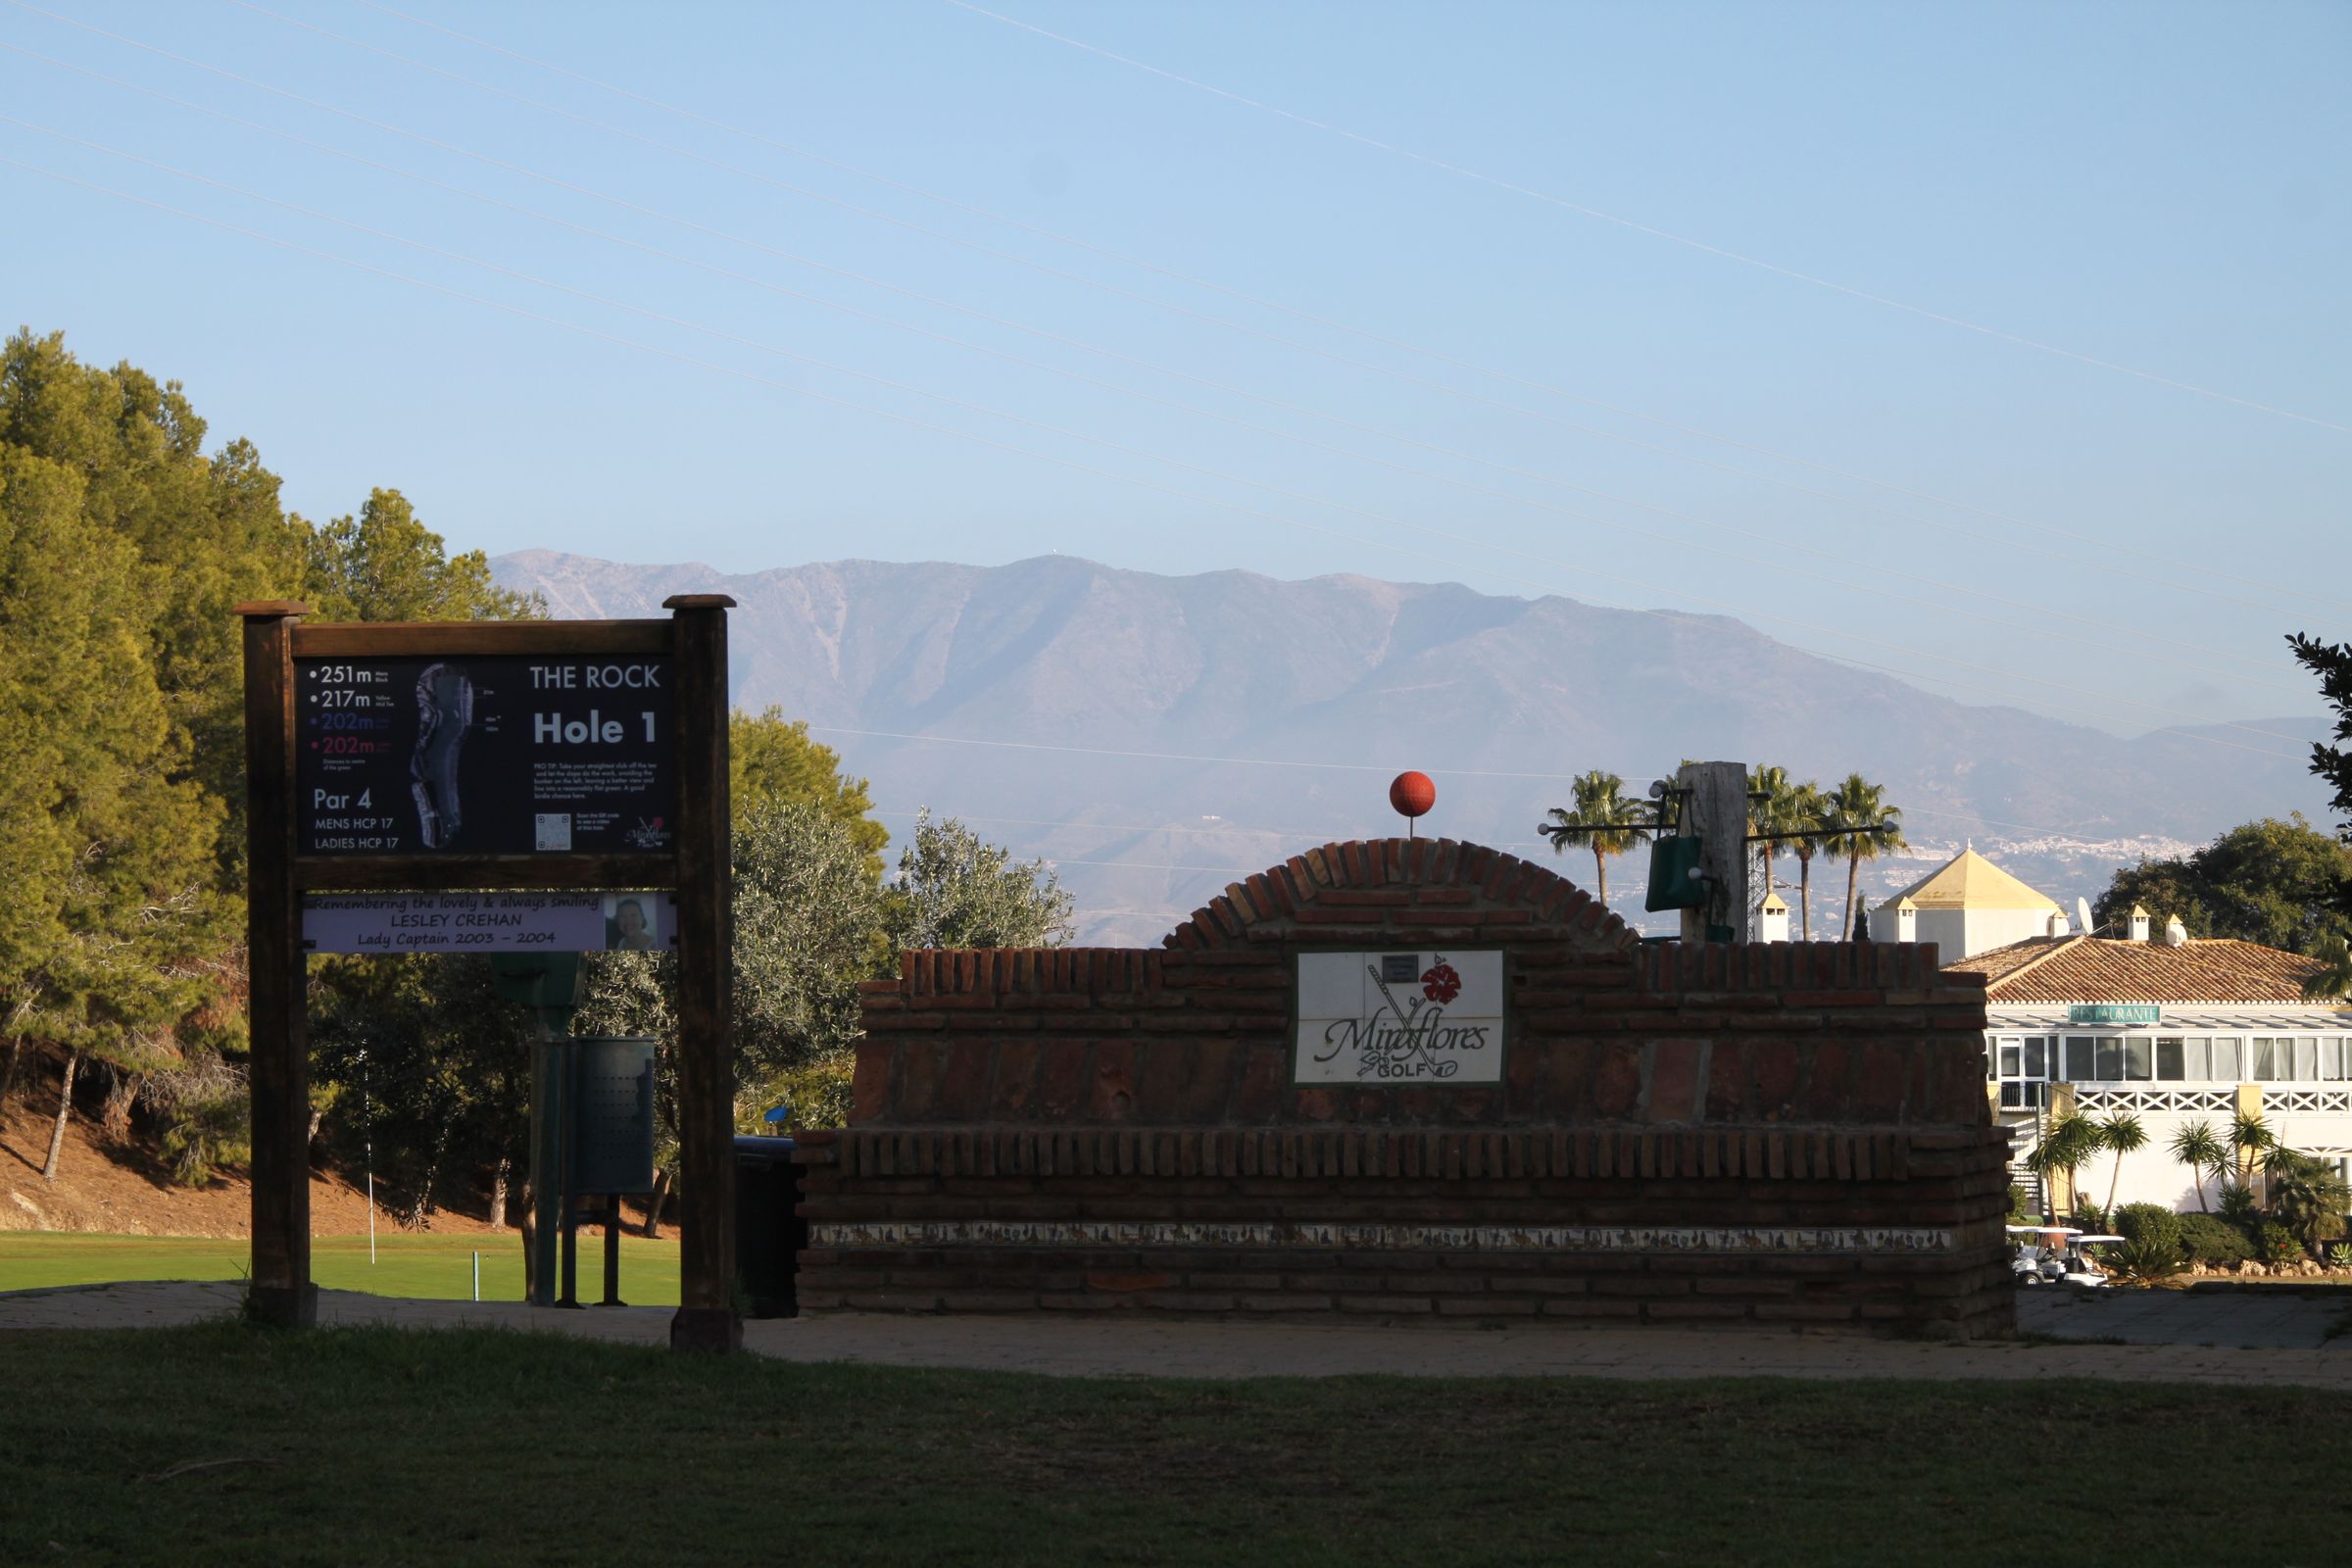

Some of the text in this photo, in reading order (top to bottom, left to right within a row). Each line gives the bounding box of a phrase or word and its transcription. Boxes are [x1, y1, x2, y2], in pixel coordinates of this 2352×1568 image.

[320, 665, 371, 683] 251m
[529, 665, 661, 688] THE ROCK
[321, 690, 370, 707] 217m
[321, 713, 373, 729] 202m
[534, 709, 656, 744] Hole 1
[322, 737, 374, 753] 202m
[314, 787, 371, 809] Par 4
[316, 817, 394, 829] MENS HCP 17
[315, 837, 399, 849] LADIES HCP 17
[315, 895, 600, 912] Remembering the lovely & always smiling
[392, 913, 523, 927] LESLEY CREHAN
[358, 933, 391, 948] Lady
[396, 932, 450, 948] Captain
[455, 933, 495, 944] 2003
[516, 932, 557, 944] 2004
[2071, 1006, 2156, 1021] RESTAURANTE
[1314, 1006, 1490, 1062] Miraflores
[1378, 1062, 1427, 1078] GOLF
